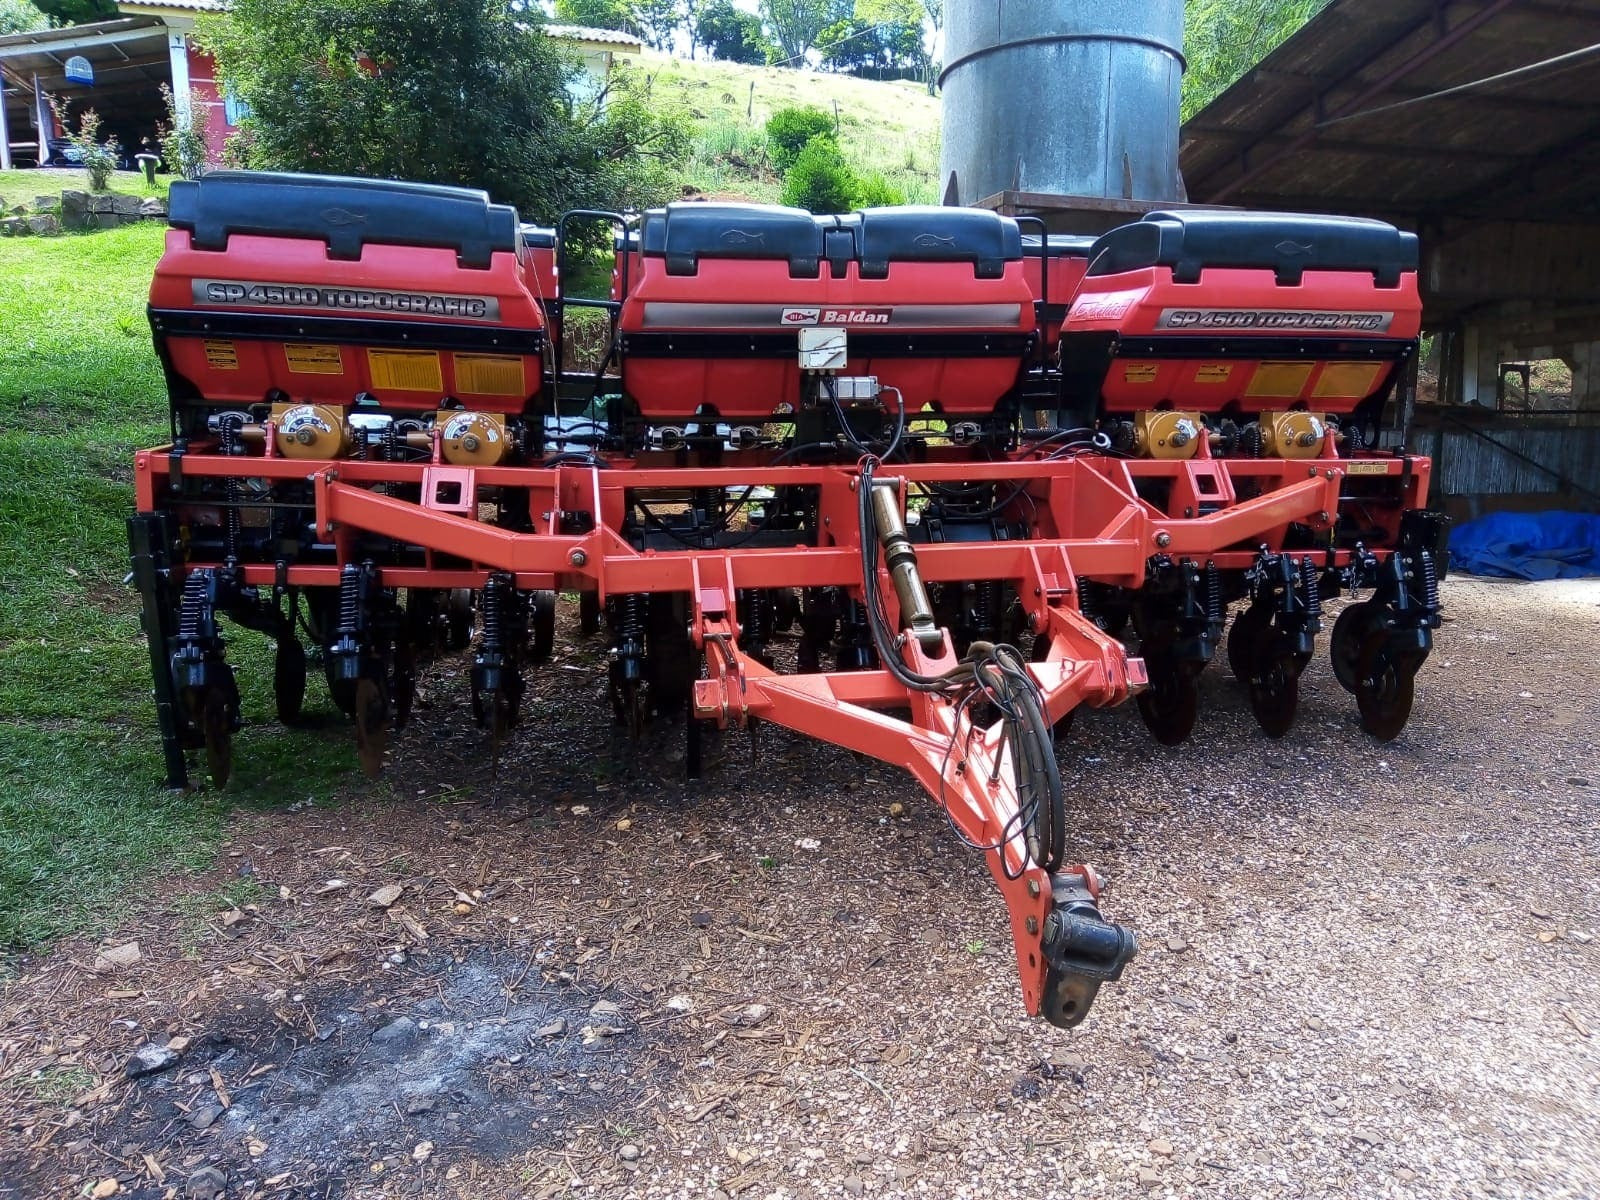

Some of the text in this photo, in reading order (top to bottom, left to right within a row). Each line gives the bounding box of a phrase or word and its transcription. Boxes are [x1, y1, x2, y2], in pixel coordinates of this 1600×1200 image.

[207, 283, 486, 317] SP 4500 TOPOGRAFIC
[823, 310, 889, 323] Baldan
[1167, 311, 1383, 330] SP 4500 TOPOGRAFIC
